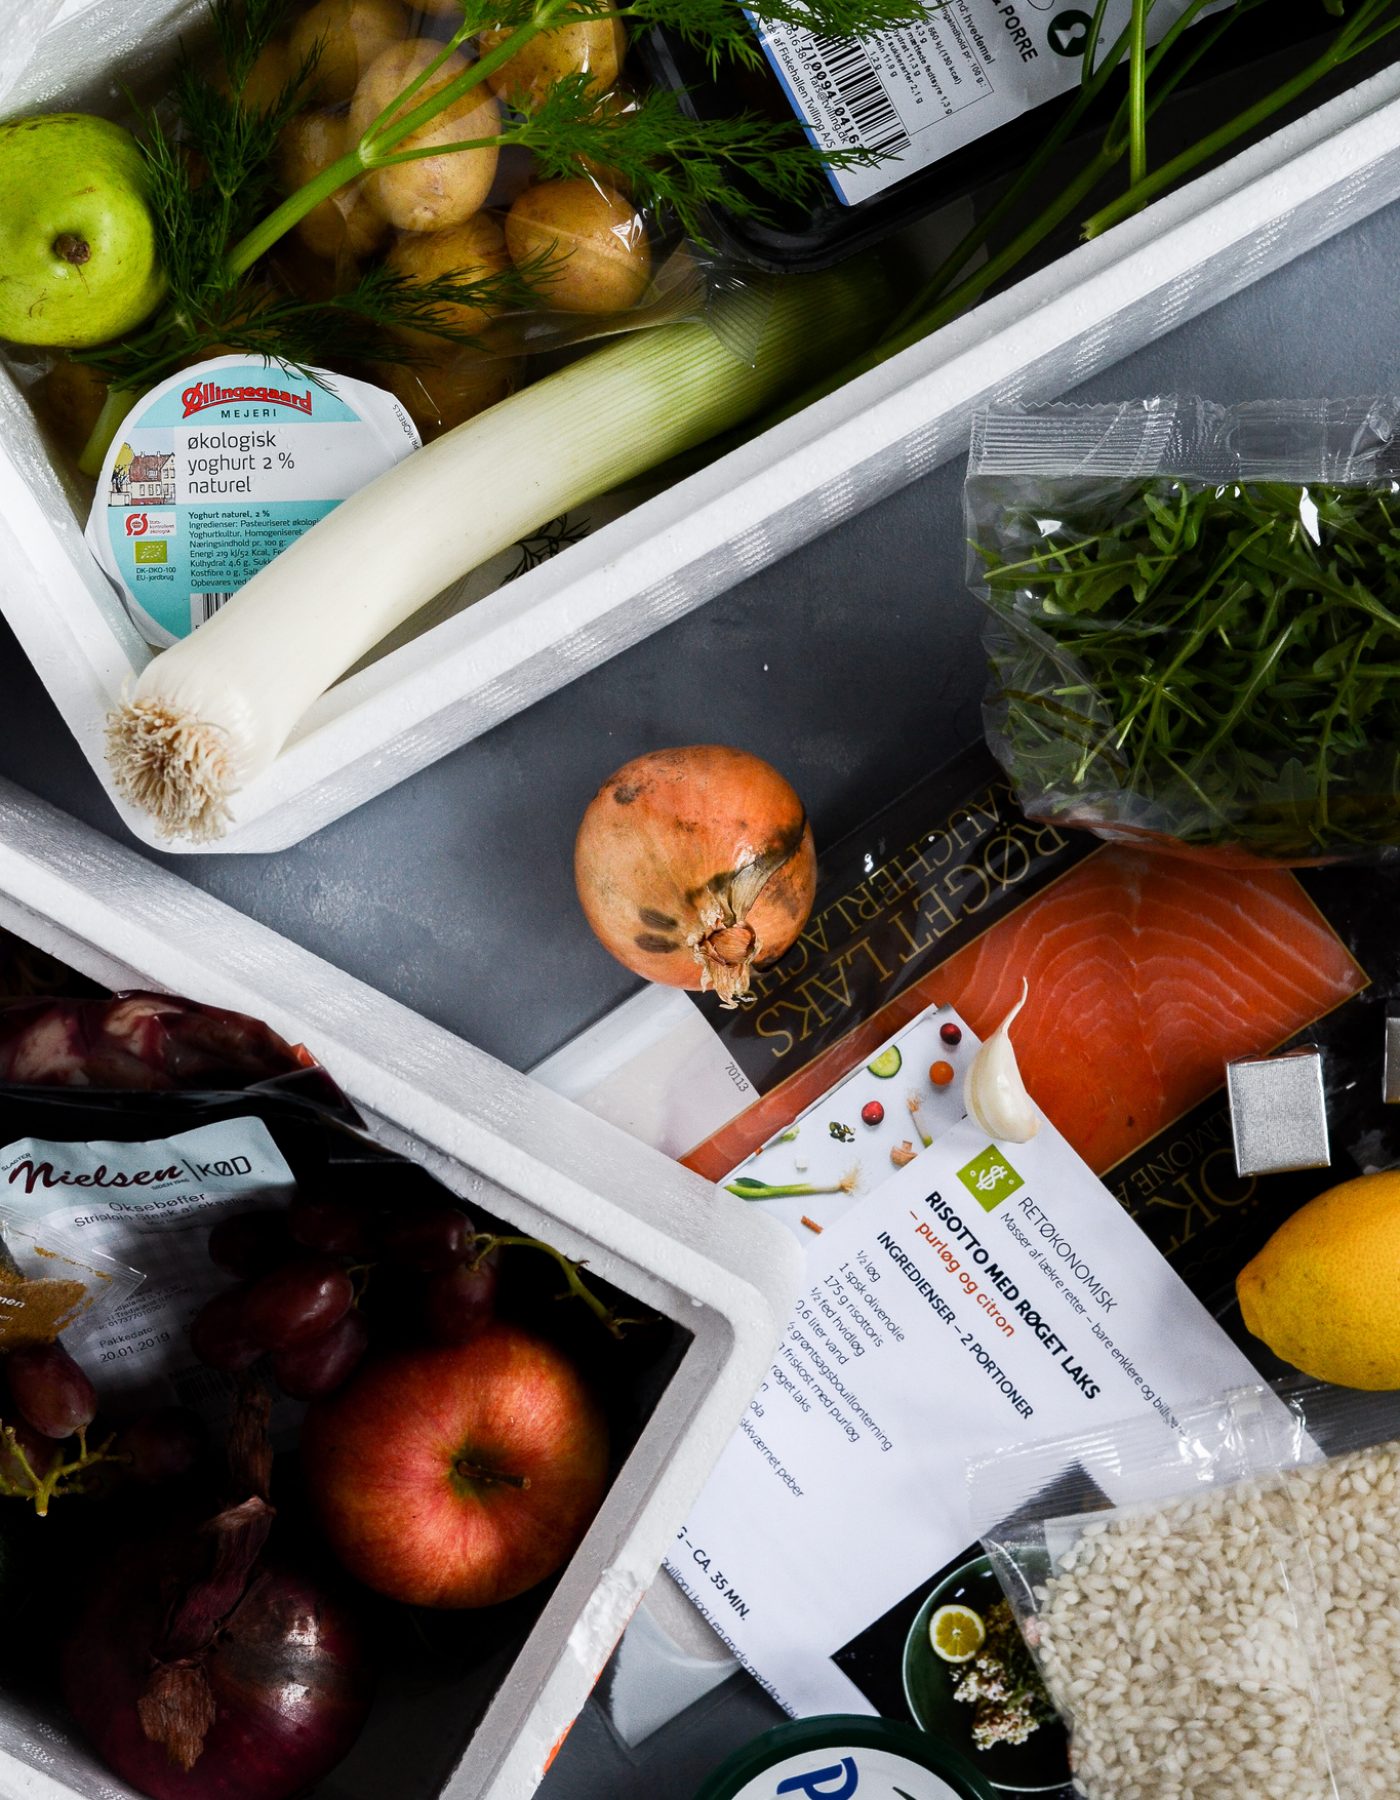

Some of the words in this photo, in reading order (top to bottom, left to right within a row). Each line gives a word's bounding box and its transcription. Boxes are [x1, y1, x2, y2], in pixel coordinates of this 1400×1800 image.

[772, 37, 785, 47] af
[962, 13, 996, 65] hvedemel
[997, 4, 1038, 63] PORRE
[777, 46, 810, 98] Fiskehallen
[799, 42, 837, 100] 710094
[873, 63, 882, 71] g
[887, 41, 914, 83] sukkerarter
[909, 83, 921, 96] 2,1
[915, 96, 923, 104] g
[889, 70, 898, 78] g
[912, 69, 921, 77] g
[923, 64, 942, 95] fedtsyre
[969, 62, 982, 76] 100
[803, 96, 827, 132] Tvilling
[182, 382, 312, 418] Øllingegaard
[221, 409, 277, 418] MEJERI
[188, 431, 277, 452] økologisk
[188, 454, 256, 475] yoghurt
[263, 457, 272, 470] 2
[278, 452, 295, 469] %
[189, 476, 252, 494] naturel
[188, 511, 219, 520] Yoghurt
[189, 521, 238, 529] Ingredienser:
[240, 519, 290, 528] Pasteuriseret
[190, 540, 250, 548] Næringsindhold
[190, 550, 214, 558] Energi
[190, 560, 226, 568] Kulhydrat
[190, 568, 224, 577] Kostfibre
[191, 579, 231, 588] Opbevares
[887, 820, 1069, 965] RØGET
[755, 936, 892, 1059] LAKS
[724, 1060, 749, 1092] 70113
[8, 1160, 180, 1194] Nielsen
[195, 1154, 251, 1177] KØD
[108, 1192, 205, 1212] Oksebøffer
[863, 1261, 881, 1283] løg
[1017, 1196, 1118, 1313] RETØKONOMISK
[914, 1222, 960, 1273] purløg
[958, 1271, 978, 1294] og
[975, 1293, 1014, 1337] citron
[924, 1190, 989, 1265] RISOTTO
[983, 1262, 1019, 1301] MED
[1014, 1298, 1067, 1356] RØGET
[1060, 1355, 1100, 1399] LAKS
[823, 1274, 844, 1296] 175
[836, 1294, 849, 1306] g
[845, 1303, 883, 1347] risottoris
[838, 1262, 849, 1273] 1
[844, 1271, 866, 1295] spsk
[863, 1293, 905, 1342] olivenolie
[999, 1212, 1032, 1248] Masser
[1028, 1248, 1043, 1260] af
[1037, 1257, 1064, 1289] lækre
[1060, 1287, 1087, 1315] retter
[1090, 1322, 1113, 1349] bare
[1110, 1347, 1143, 1386] enklere
[1140, 1384, 1155, 1401] og
[98, 1324, 157, 1348] Pakkedato:
[807, 1316, 827, 1338] liter
[824, 1338, 850, 1365] vand
[818, 1298, 837, 1319] fed
[831, 1315, 865, 1357] hvidløg
[876, 1231, 956, 1325] INGREDIENSER
[959, 1332, 973, 1346] 2
[968, 1342, 1034, 1419] PORTIONER
[770, 1364, 795, 1393] røget
[791, 1389, 811, 1413] laks
[782, 1347, 814, 1385] friskost
[810, 1383, 835, 1408] med
[827, 1406, 860, 1443] purløg
[789, 1329, 893, 1452] grøntsagsbouillonterning
[774, 1467, 804, 1497] peber
[692, 1548, 711, 1573] CA.
[709, 1570, 728, 1590] 35
[722, 1588, 750, 1620] MIN.
